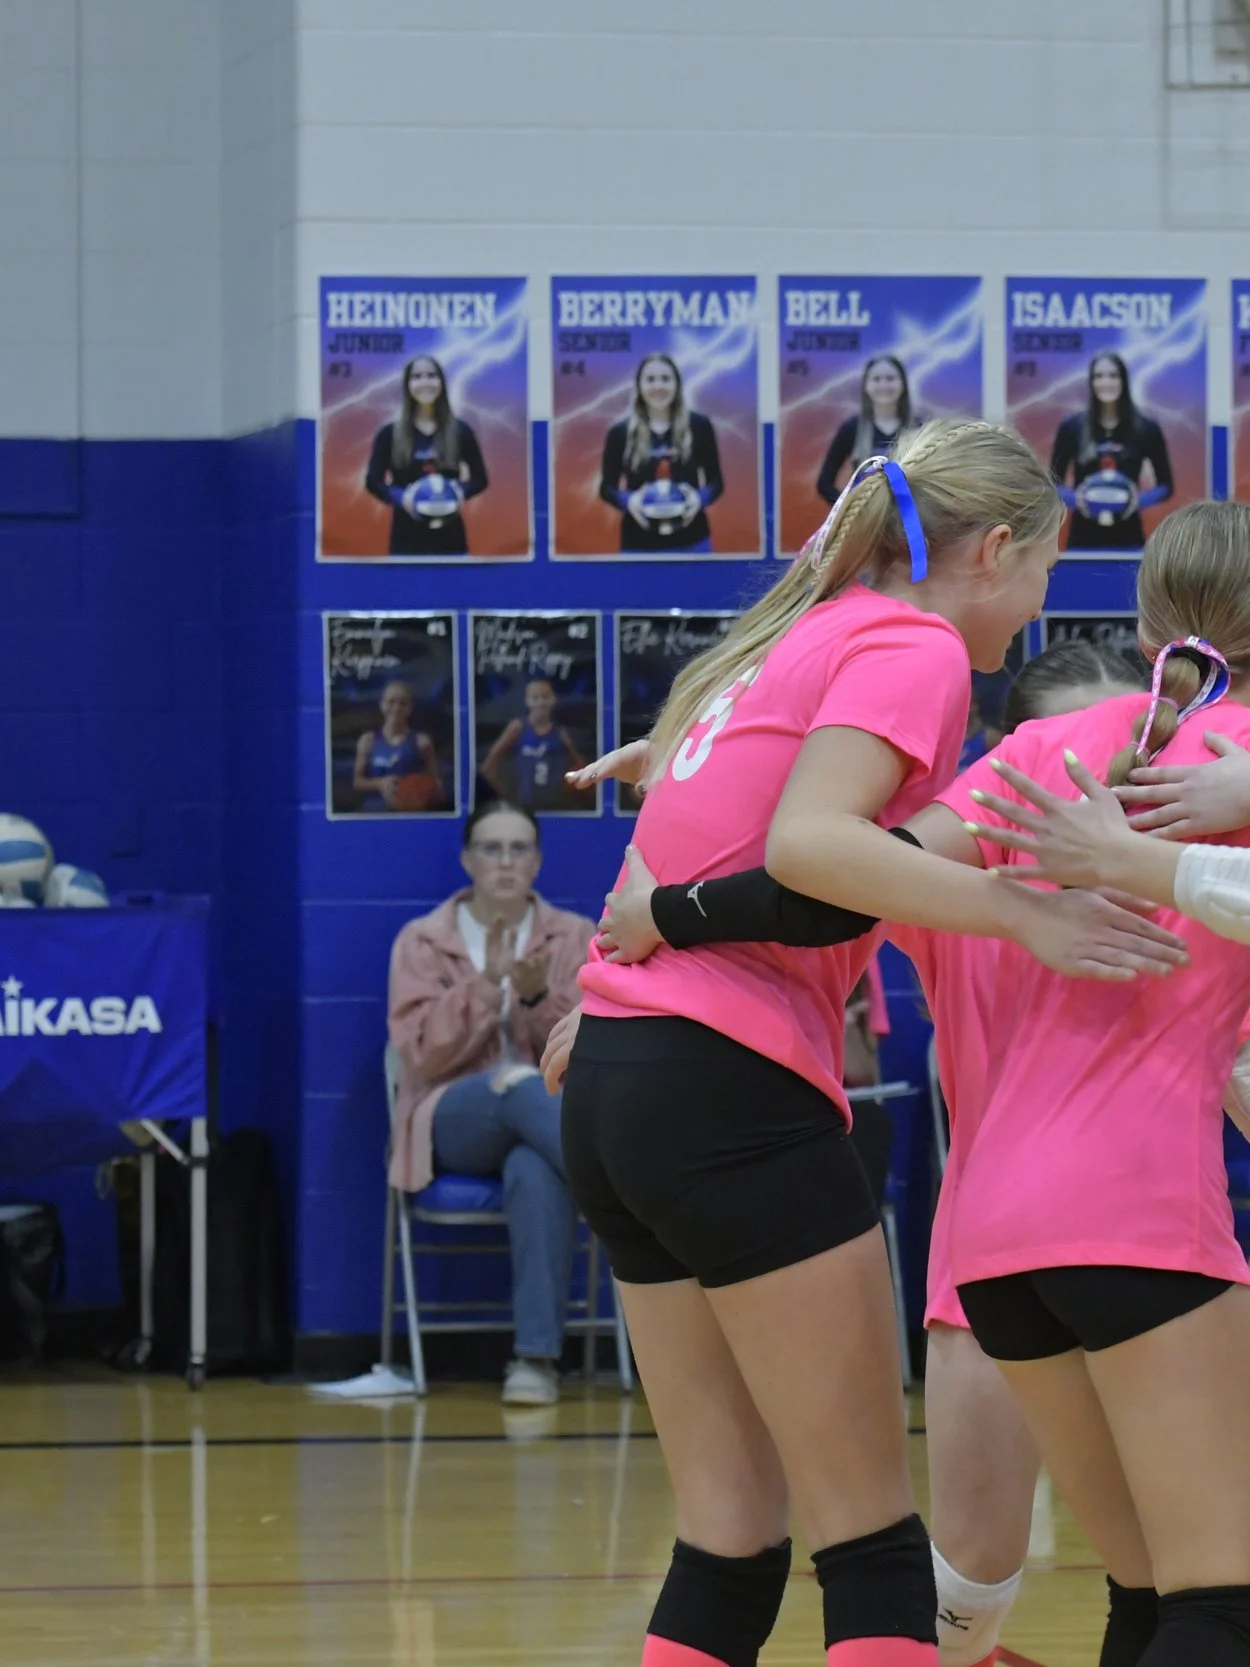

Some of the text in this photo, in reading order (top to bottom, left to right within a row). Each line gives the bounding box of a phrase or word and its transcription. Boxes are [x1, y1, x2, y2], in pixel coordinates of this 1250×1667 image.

[327, 291, 497, 328] HEINONEN
[558, 290, 751, 327] BERRYMAN
[785, 290, 871, 327] BELL
[1011, 291, 1173, 329] ISAACSON
[328, 333, 405, 354] JUNIOR
[558, 332, 632, 352] SENIOR
[0, 976, 163, 1037] IKASA
